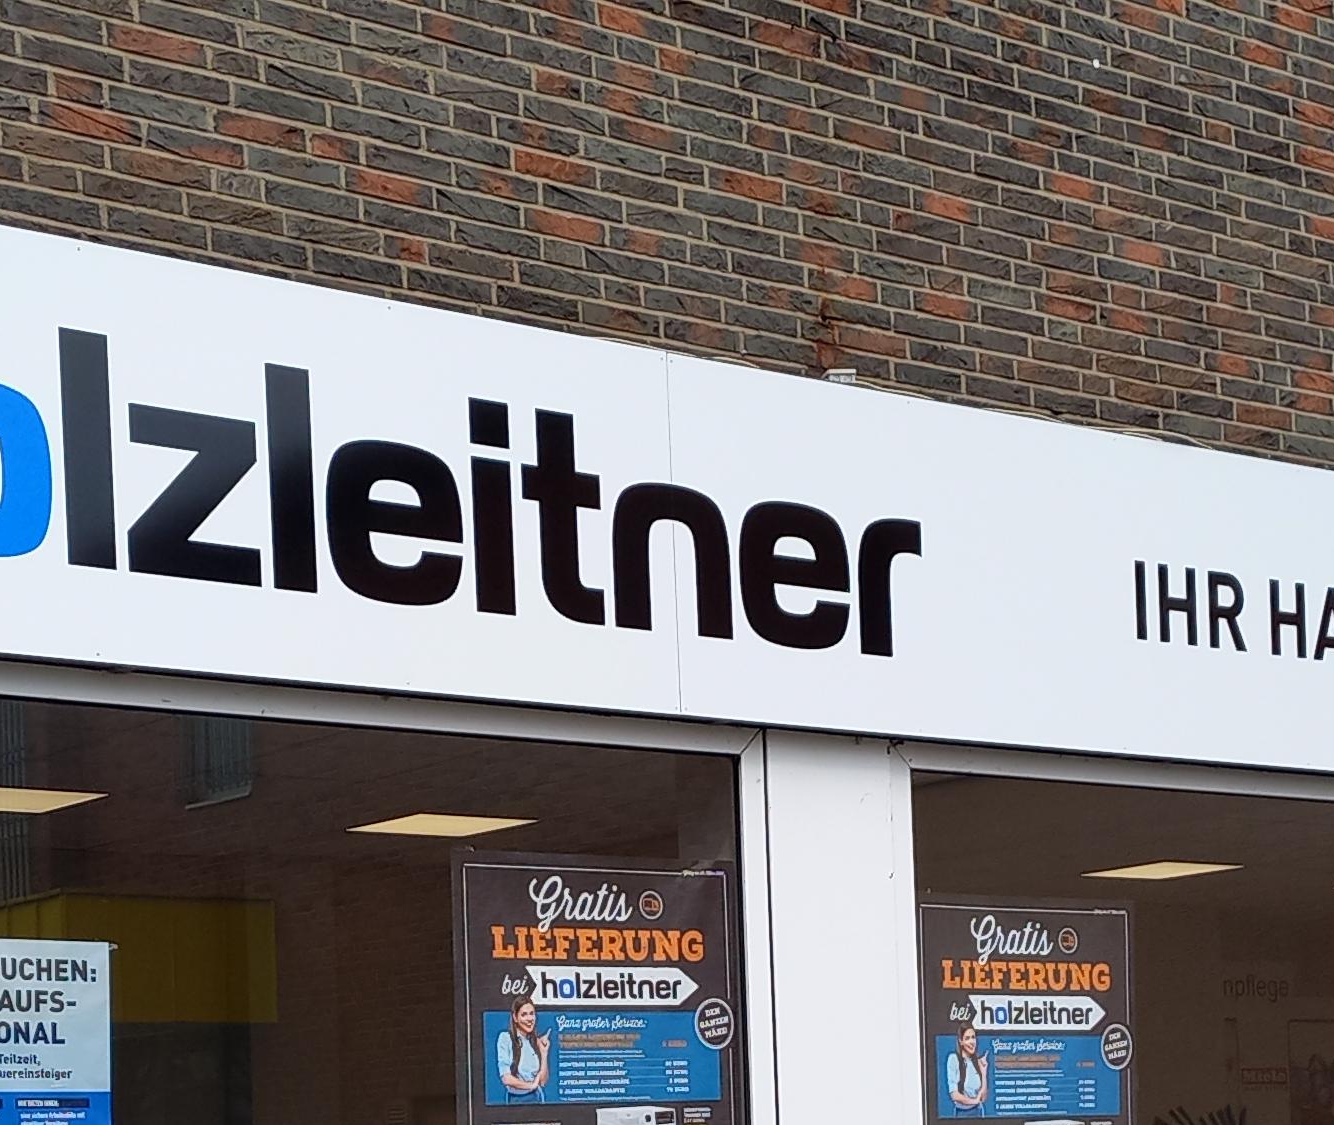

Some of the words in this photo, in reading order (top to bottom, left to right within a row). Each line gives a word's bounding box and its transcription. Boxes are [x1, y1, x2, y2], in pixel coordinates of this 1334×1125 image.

[1133, 559, 1248, 653] IHR
[528, 875, 633, 933] Gratis
[490, 925, 705, 962] LIEFERUNG
[970, 914, 1054, 965] Gratis
[502, 974, 529, 995] bei
[541, 972, 682, 1000] holzleitner
[941, 959, 1111, 991] LIEFERUNG
[950, 1002, 972, 1021] bei
[981, 1000, 1093, 1025] holzleitner
